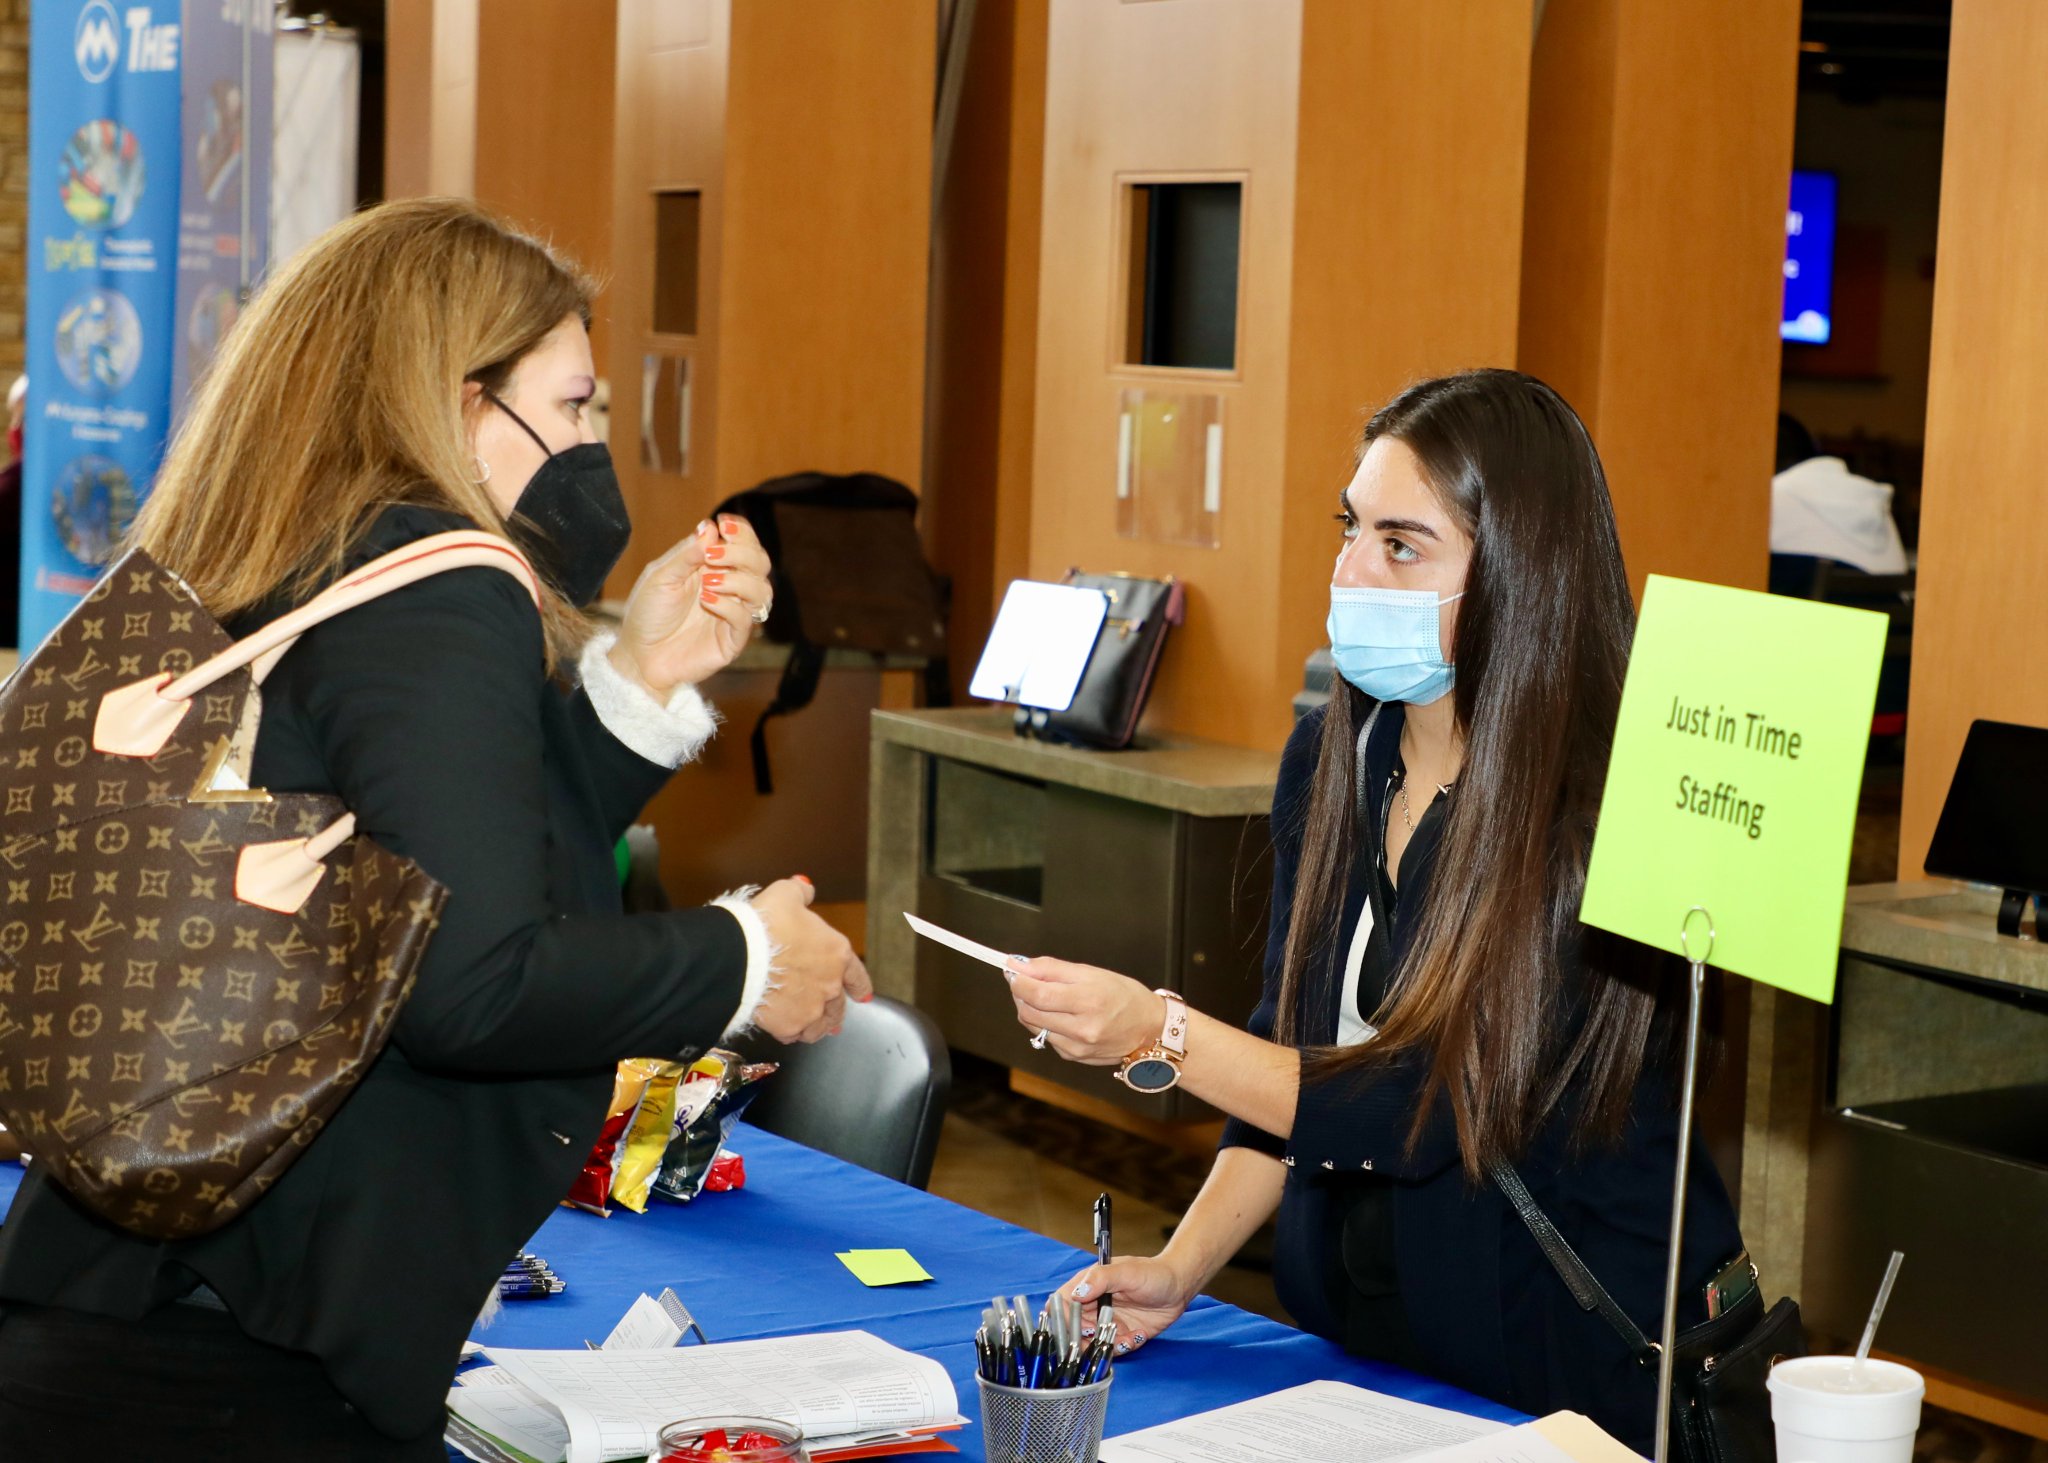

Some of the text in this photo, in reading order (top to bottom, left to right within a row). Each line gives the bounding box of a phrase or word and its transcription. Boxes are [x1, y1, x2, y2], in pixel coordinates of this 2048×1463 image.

[125, 7, 179, 72] THE
[1666, 696, 1802, 760] Just in Time
[1676, 775, 1765, 840] Staffing
